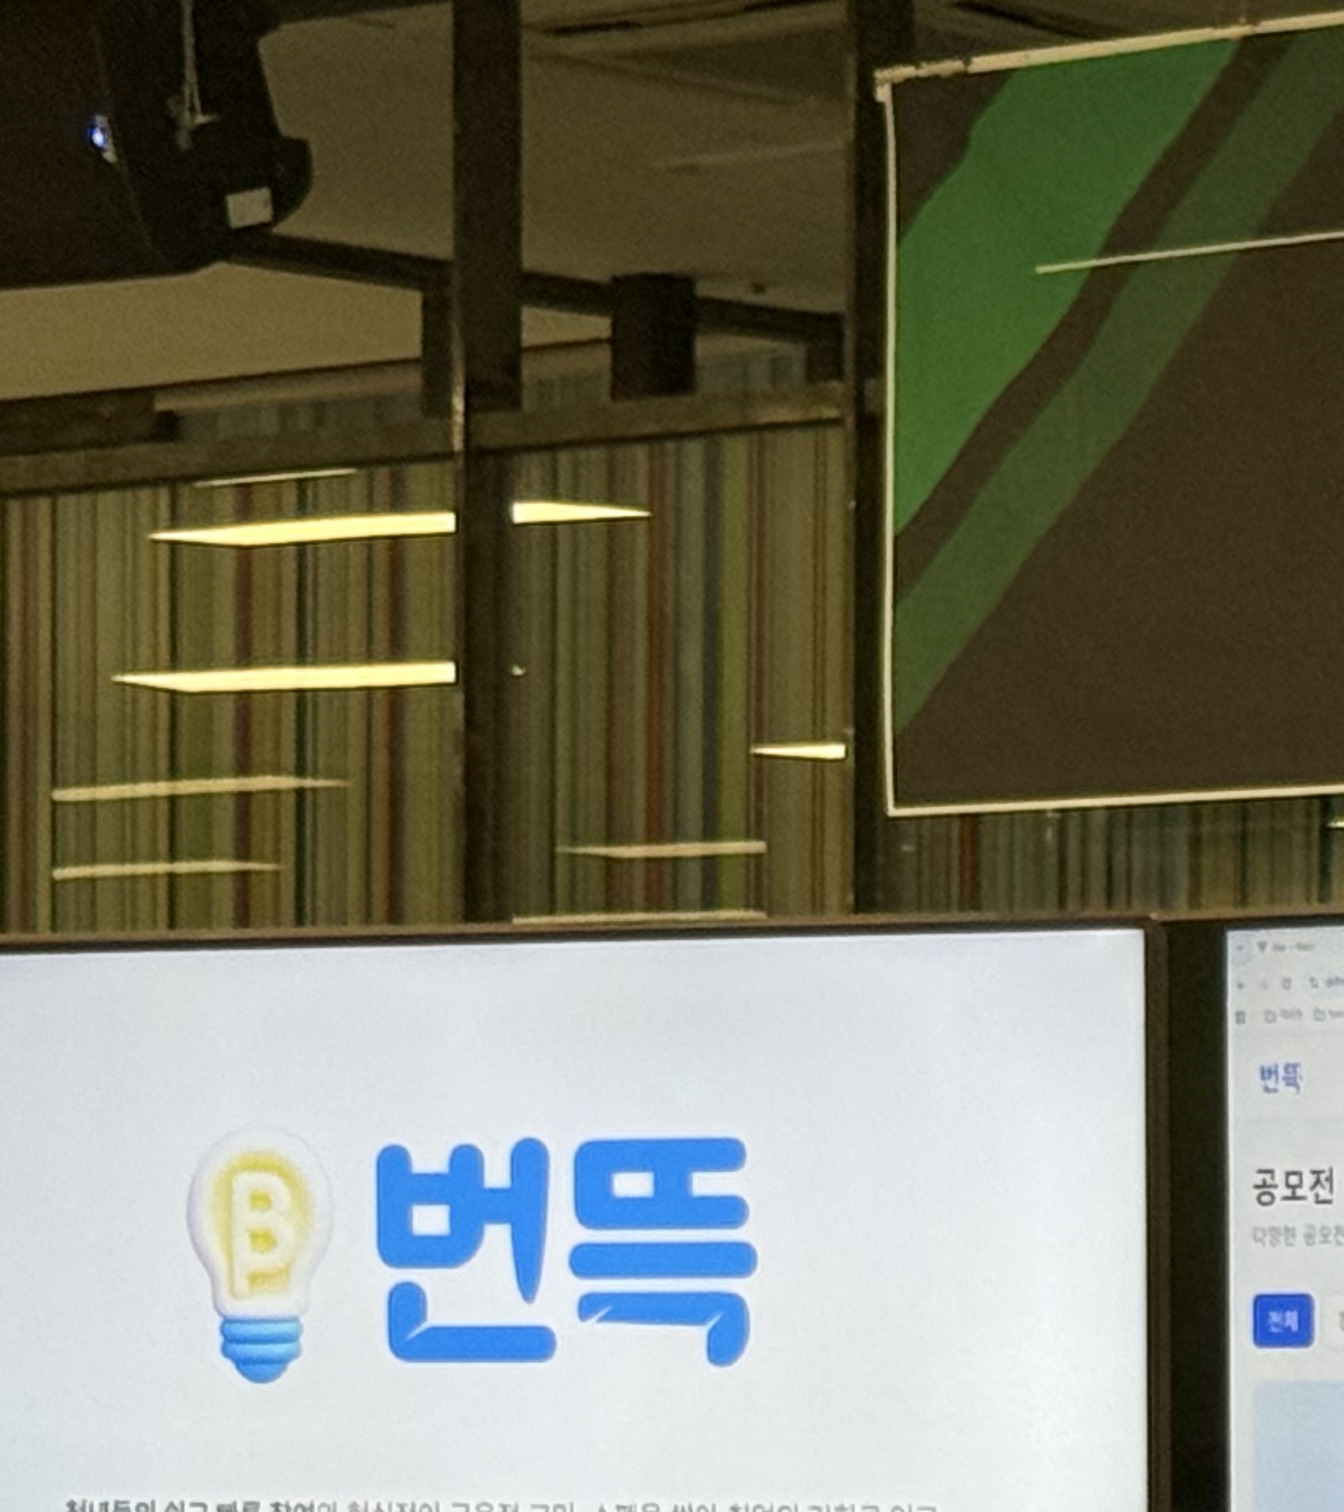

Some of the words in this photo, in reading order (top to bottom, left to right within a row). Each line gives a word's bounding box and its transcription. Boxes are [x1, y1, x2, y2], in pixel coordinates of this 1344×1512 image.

[1260, 1063, 1303, 1094] 번뜩
[1252, 1166, 1335, 1207] 공모전
[376, 1136, 758, 1367] 번뜩
[1267, 1310, 1299, 1333] 전체
